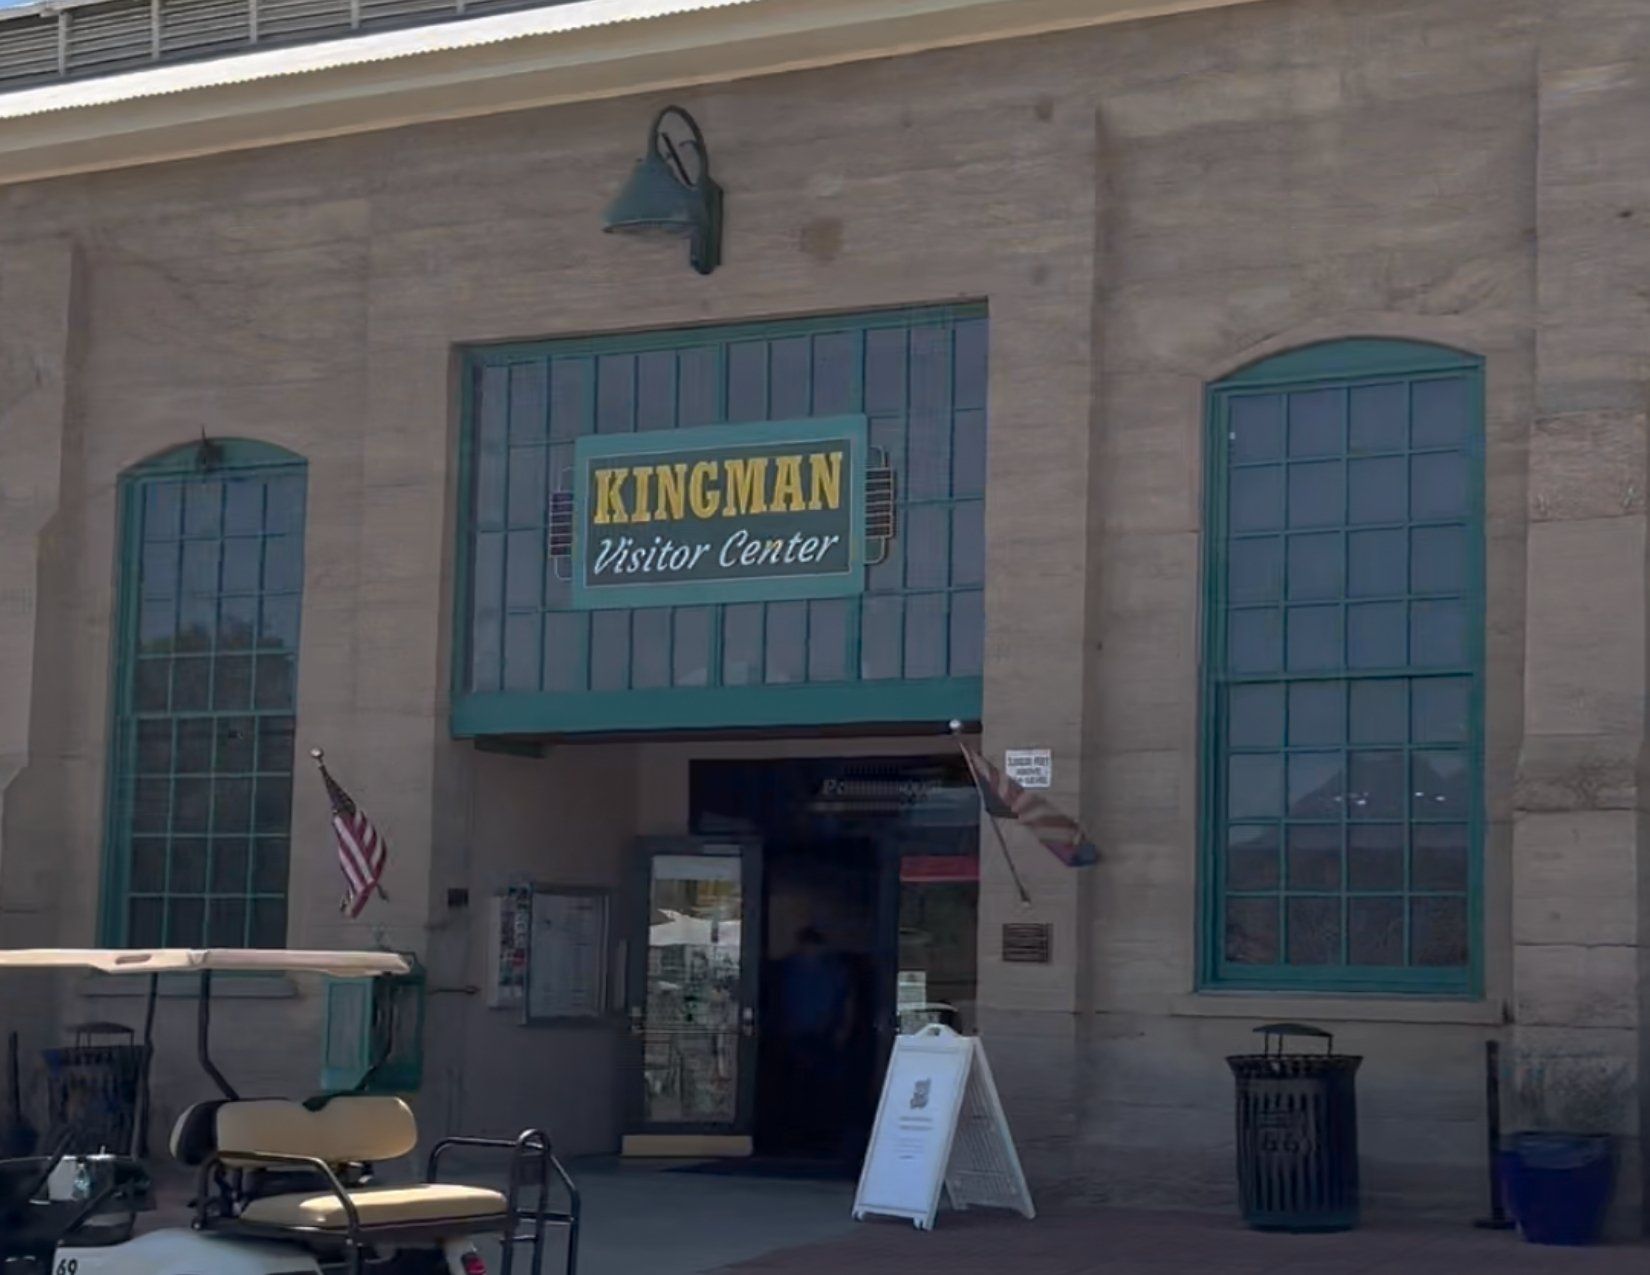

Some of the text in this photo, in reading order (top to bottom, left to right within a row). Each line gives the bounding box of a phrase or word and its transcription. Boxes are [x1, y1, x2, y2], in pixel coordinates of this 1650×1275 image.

[594, 452, 843, 524] KINGMAN
[593, 528, 839, 575] Visitor Center
[57, 1258, 78, 1275] 69
